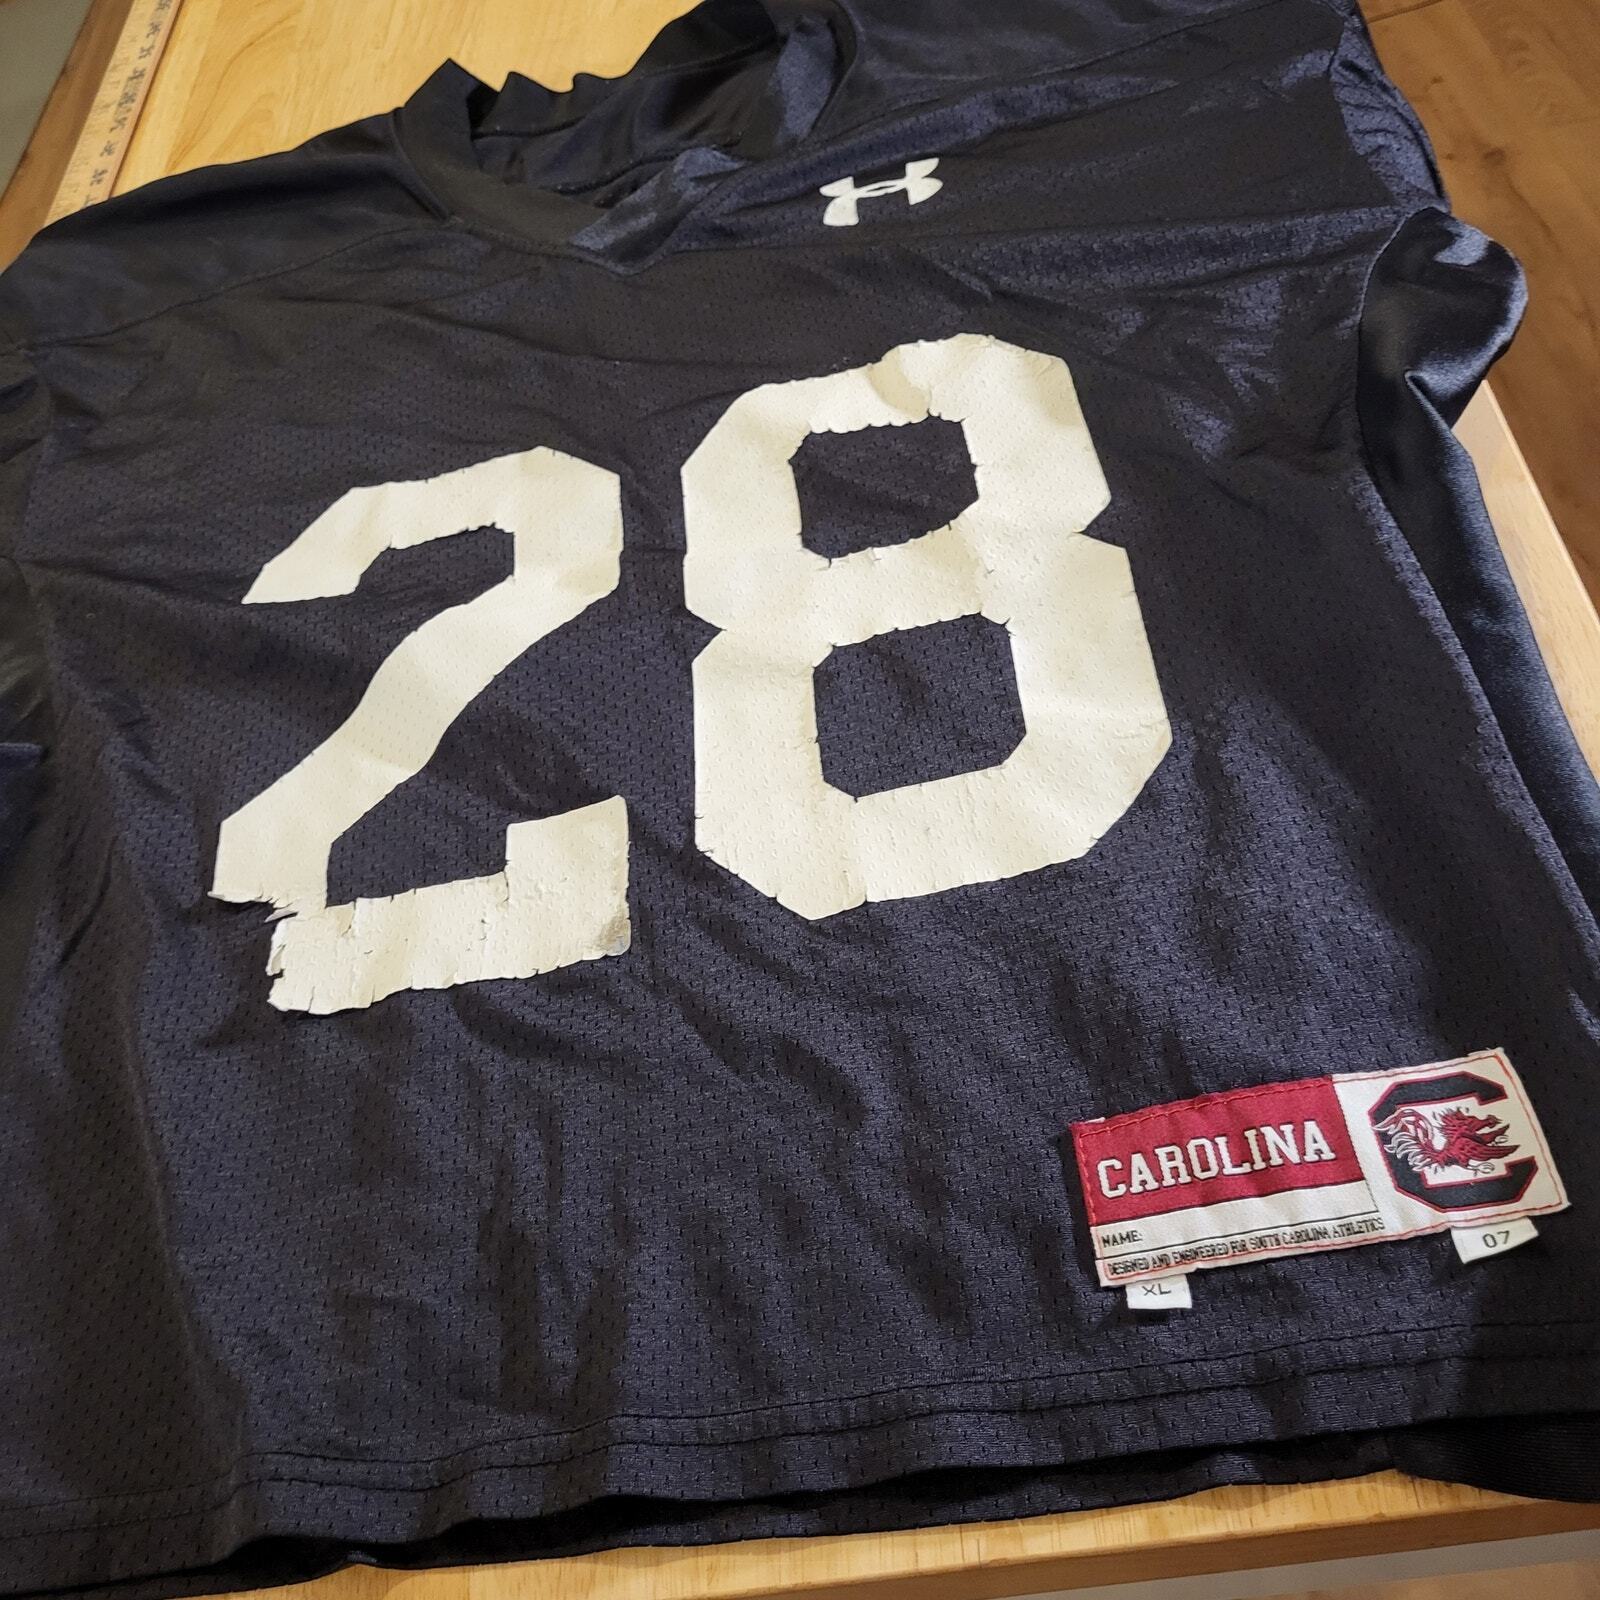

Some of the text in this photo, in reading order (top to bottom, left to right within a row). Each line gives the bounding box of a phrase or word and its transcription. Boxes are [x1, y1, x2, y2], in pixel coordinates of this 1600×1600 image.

[208, 333, 1172, 1014] 28
[1096, 1120, 1337, 1199] CAROLINA
[1107, 1216, 1386, 1276] DESIGNED AND ENGINEERED FOR SOUTH CAROLINA ATHLETICS
[1482, 1230, 1511, 1249] 07
[1141, 1282, 1172, 1297] XL
